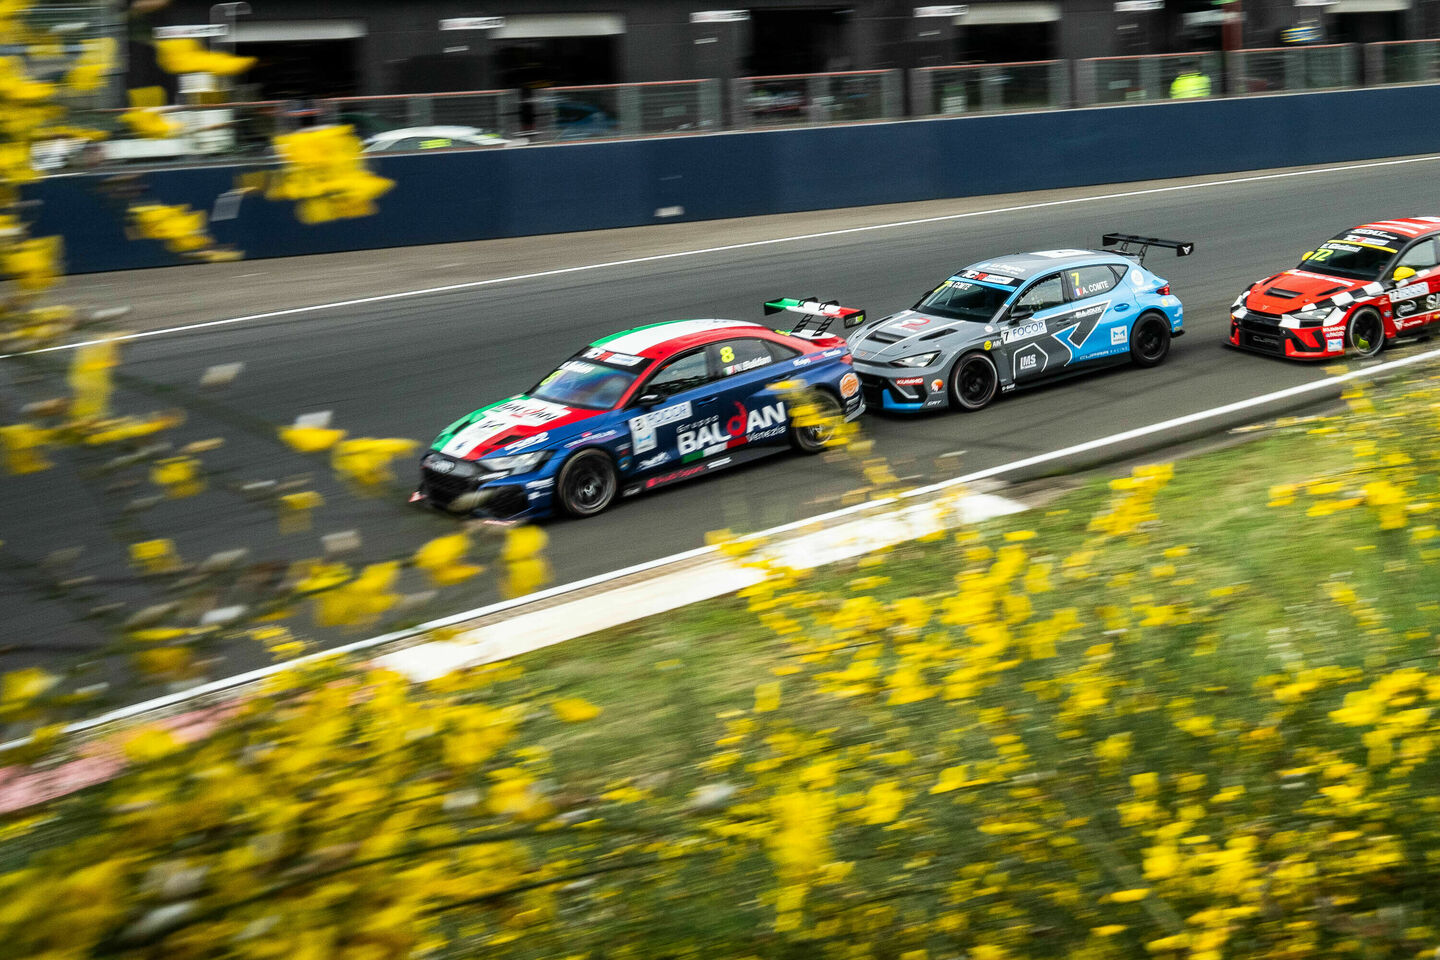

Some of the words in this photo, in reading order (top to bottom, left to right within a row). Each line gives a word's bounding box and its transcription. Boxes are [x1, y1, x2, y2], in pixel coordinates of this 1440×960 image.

[1309, 248, 1334, 261] 72
[1071, 272, 1080, 286] 7
[1089, 280, 1109, 292] COMTE
[1003, 331, 1009, 342] 7
[719, 345, 735, 363] 8
[540, 370, 563, 386] 8
[747, 425, 786, 442] Venezia
